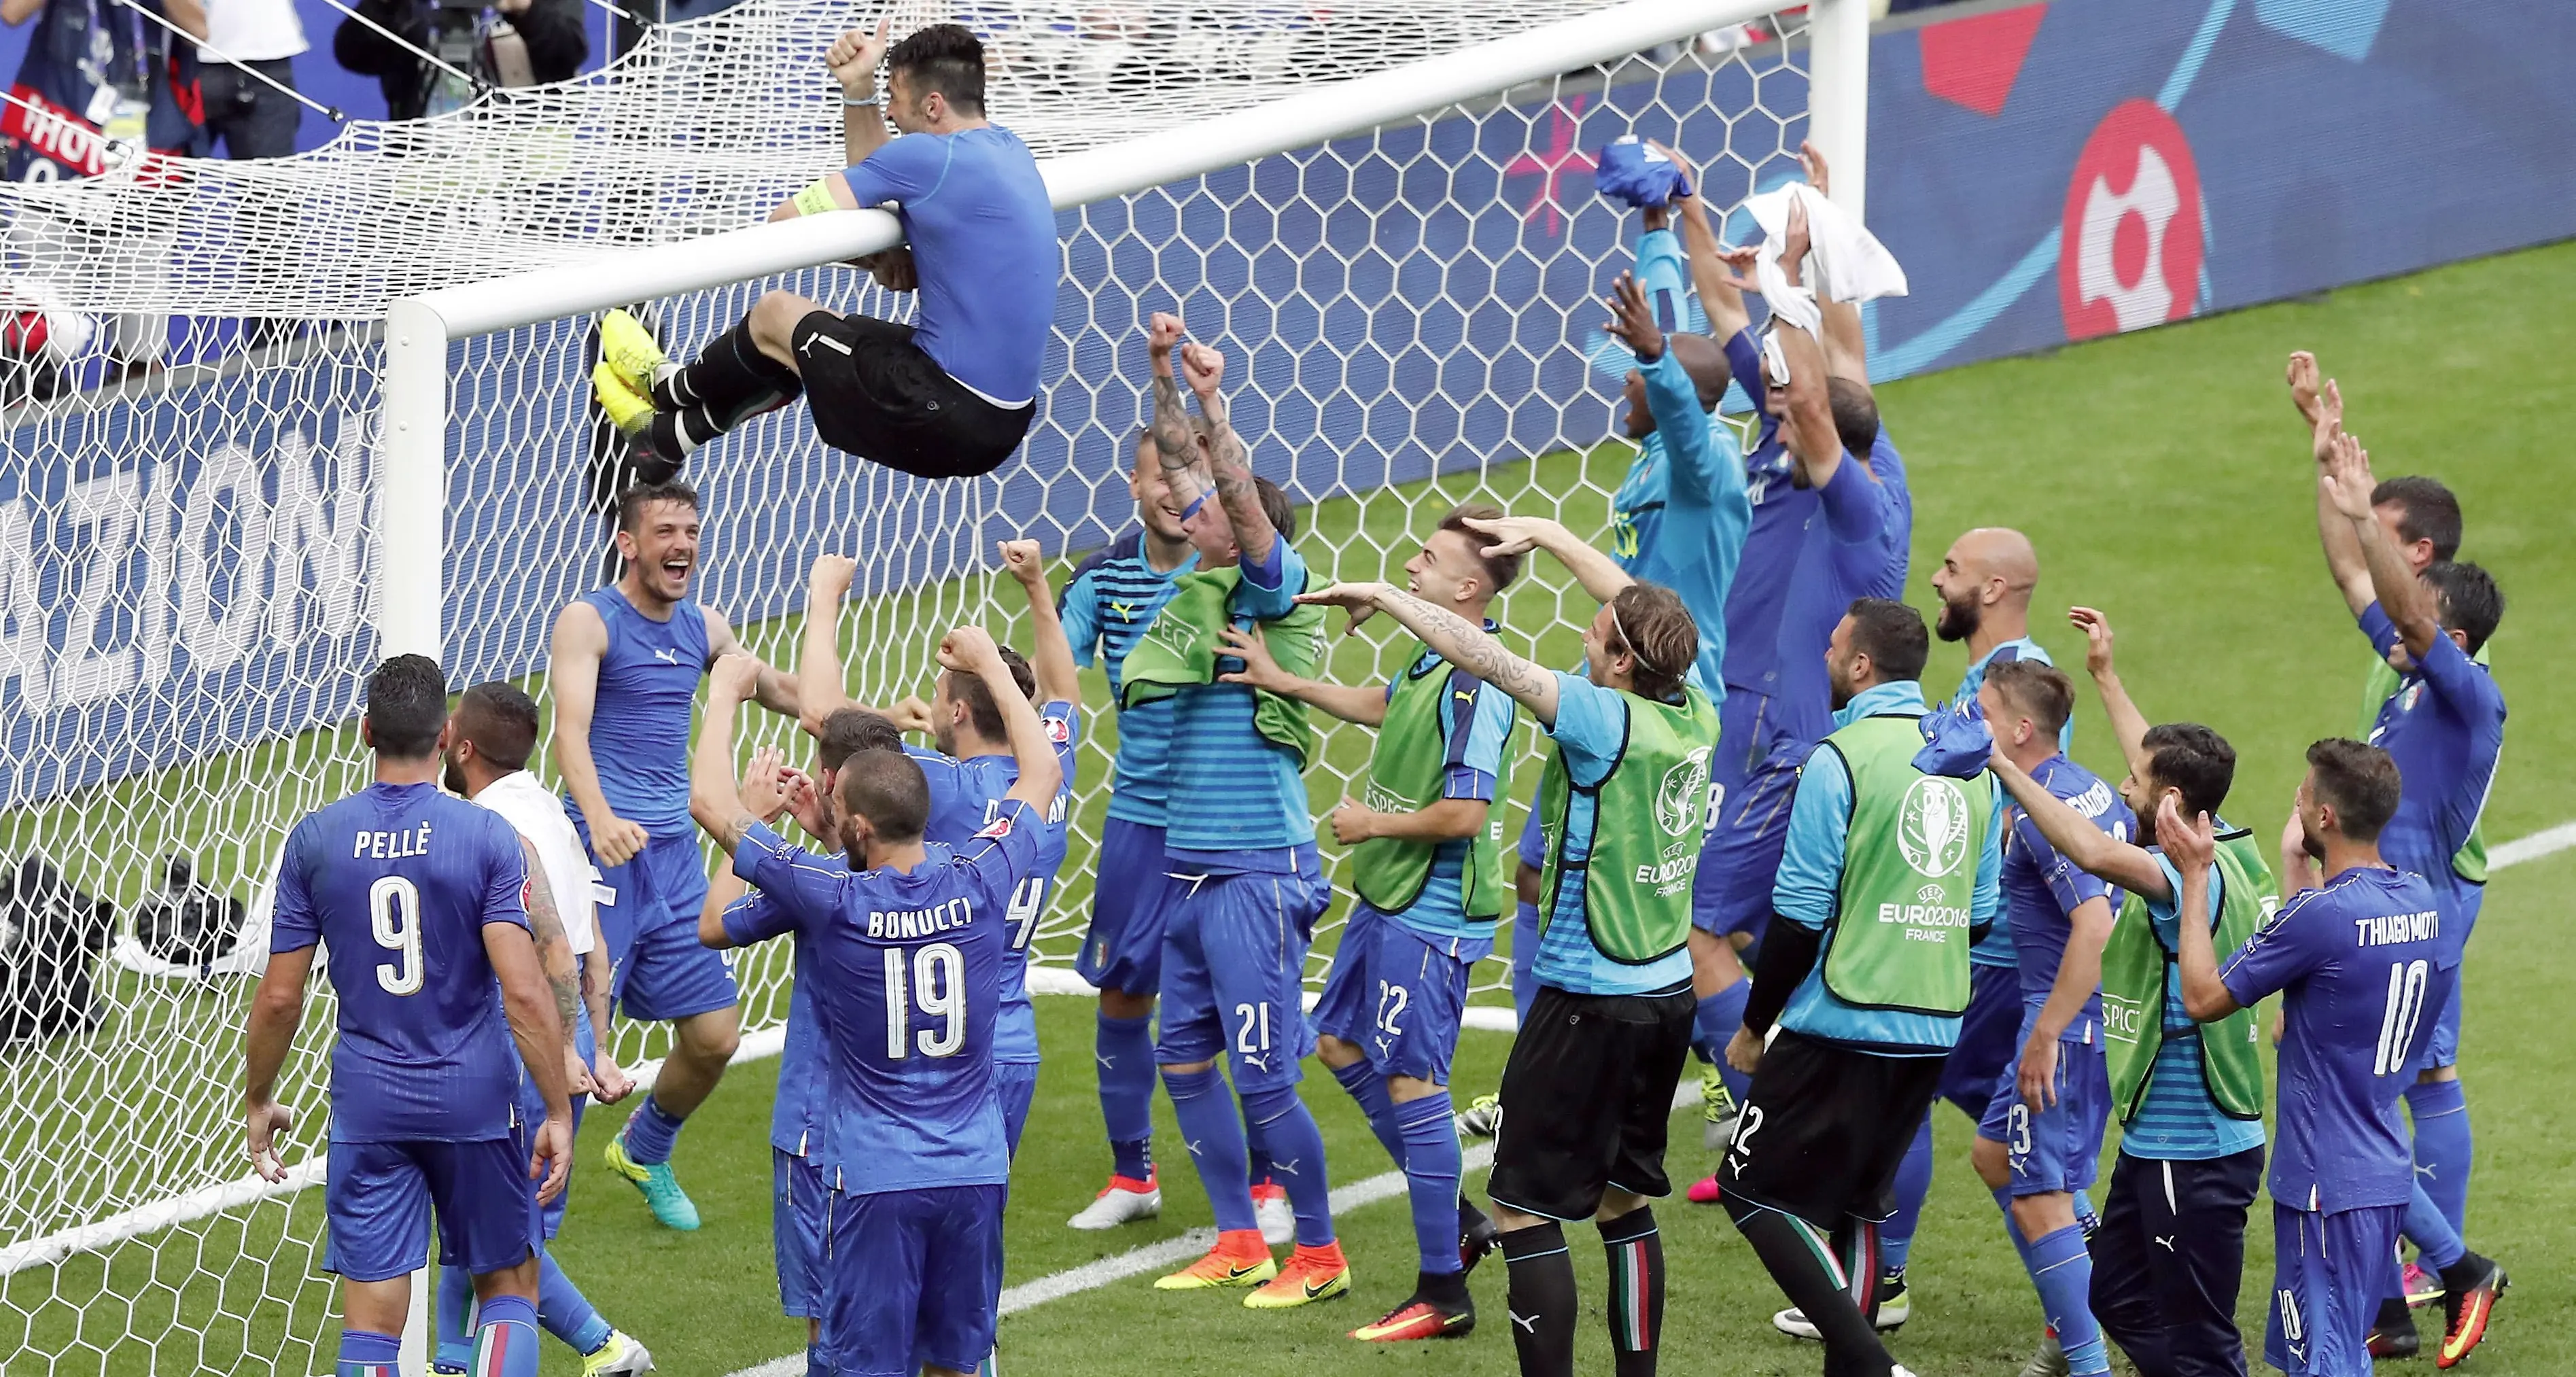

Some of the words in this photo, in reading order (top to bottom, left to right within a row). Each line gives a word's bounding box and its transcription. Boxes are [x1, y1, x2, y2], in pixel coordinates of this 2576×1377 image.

[353, 820, 432, 858] PELLÈ
[867, 897, 972, 939] BONUCCI
[1005, 877, 1044, 949] 4
[1917, 886, 1945, 903] UEFA
[369, 875, 424, 997] 9
[1905, 928, 1947, 943] FRANCE
[2355, 914, 2409, 947] THIAGO
[884, 943, 967, 1060] 19
[1376, 979, 1409, 1036] 22
[2373, 959, 2429, 1076] 10
[1235, 1002, 1270, 1053] 21
[1730, 1099, 1764, 1156] 12
[2278, 1289, 2302, 1340] 10
